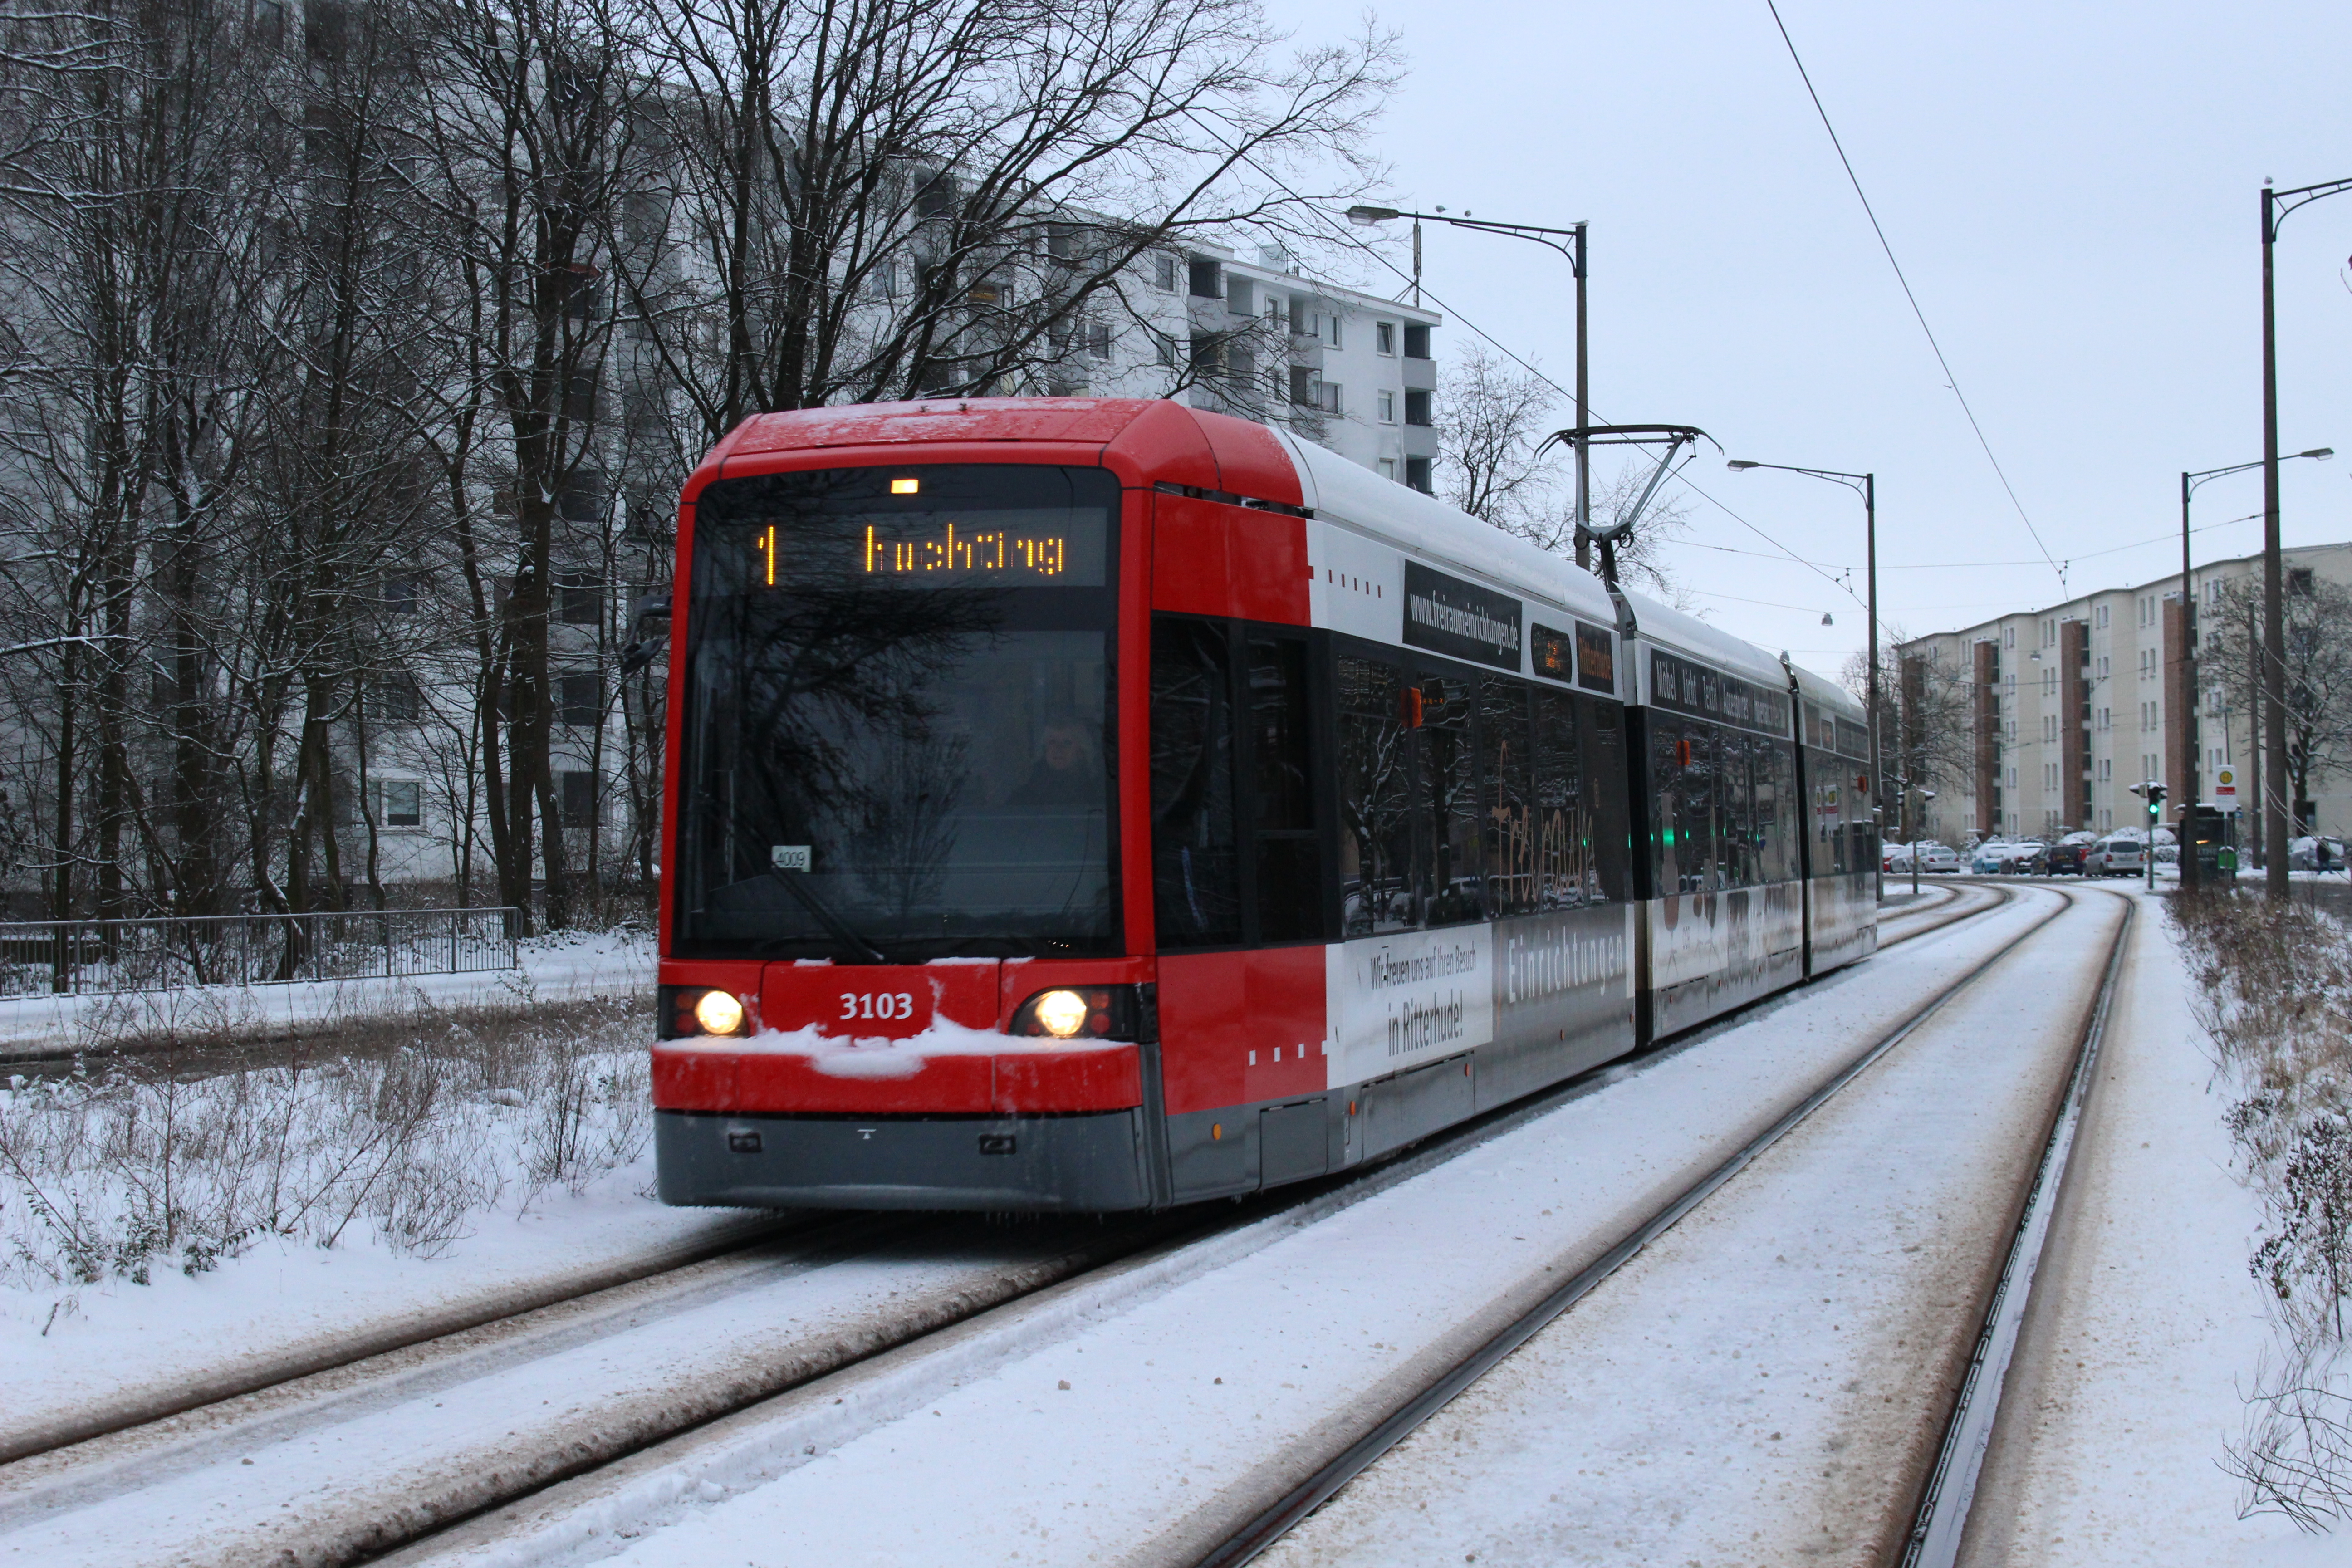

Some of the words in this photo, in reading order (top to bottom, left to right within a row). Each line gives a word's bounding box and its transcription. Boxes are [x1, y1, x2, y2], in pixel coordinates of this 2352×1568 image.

[759, 525, 774, 585] 1
[1410, 590, 1519, 655] www.freiraumeinrichtungen.de
[1656, 660, 1676, 701] Möbel
[1682, 668, 1697, 706] Licht
[775, 851, 806, 866] 4009
[1371, 954, 1384, 990] Wir
[1386, 952, 1410, 988] freuen
[1411, 956, 1423, 983] uns
[1426, 945, 1436, 979] auf
[1438, 944, 1454, 977] Ihren
[1455, 940, 1476, 975] Besuch
[1509, 926, 1622, 1004] Einrichtungen
[839, 992, 913, 1020] 3103
[1388, 1002, 1399, 1057] in
[1403, 988, 1463, 1053] Ritterhude!
